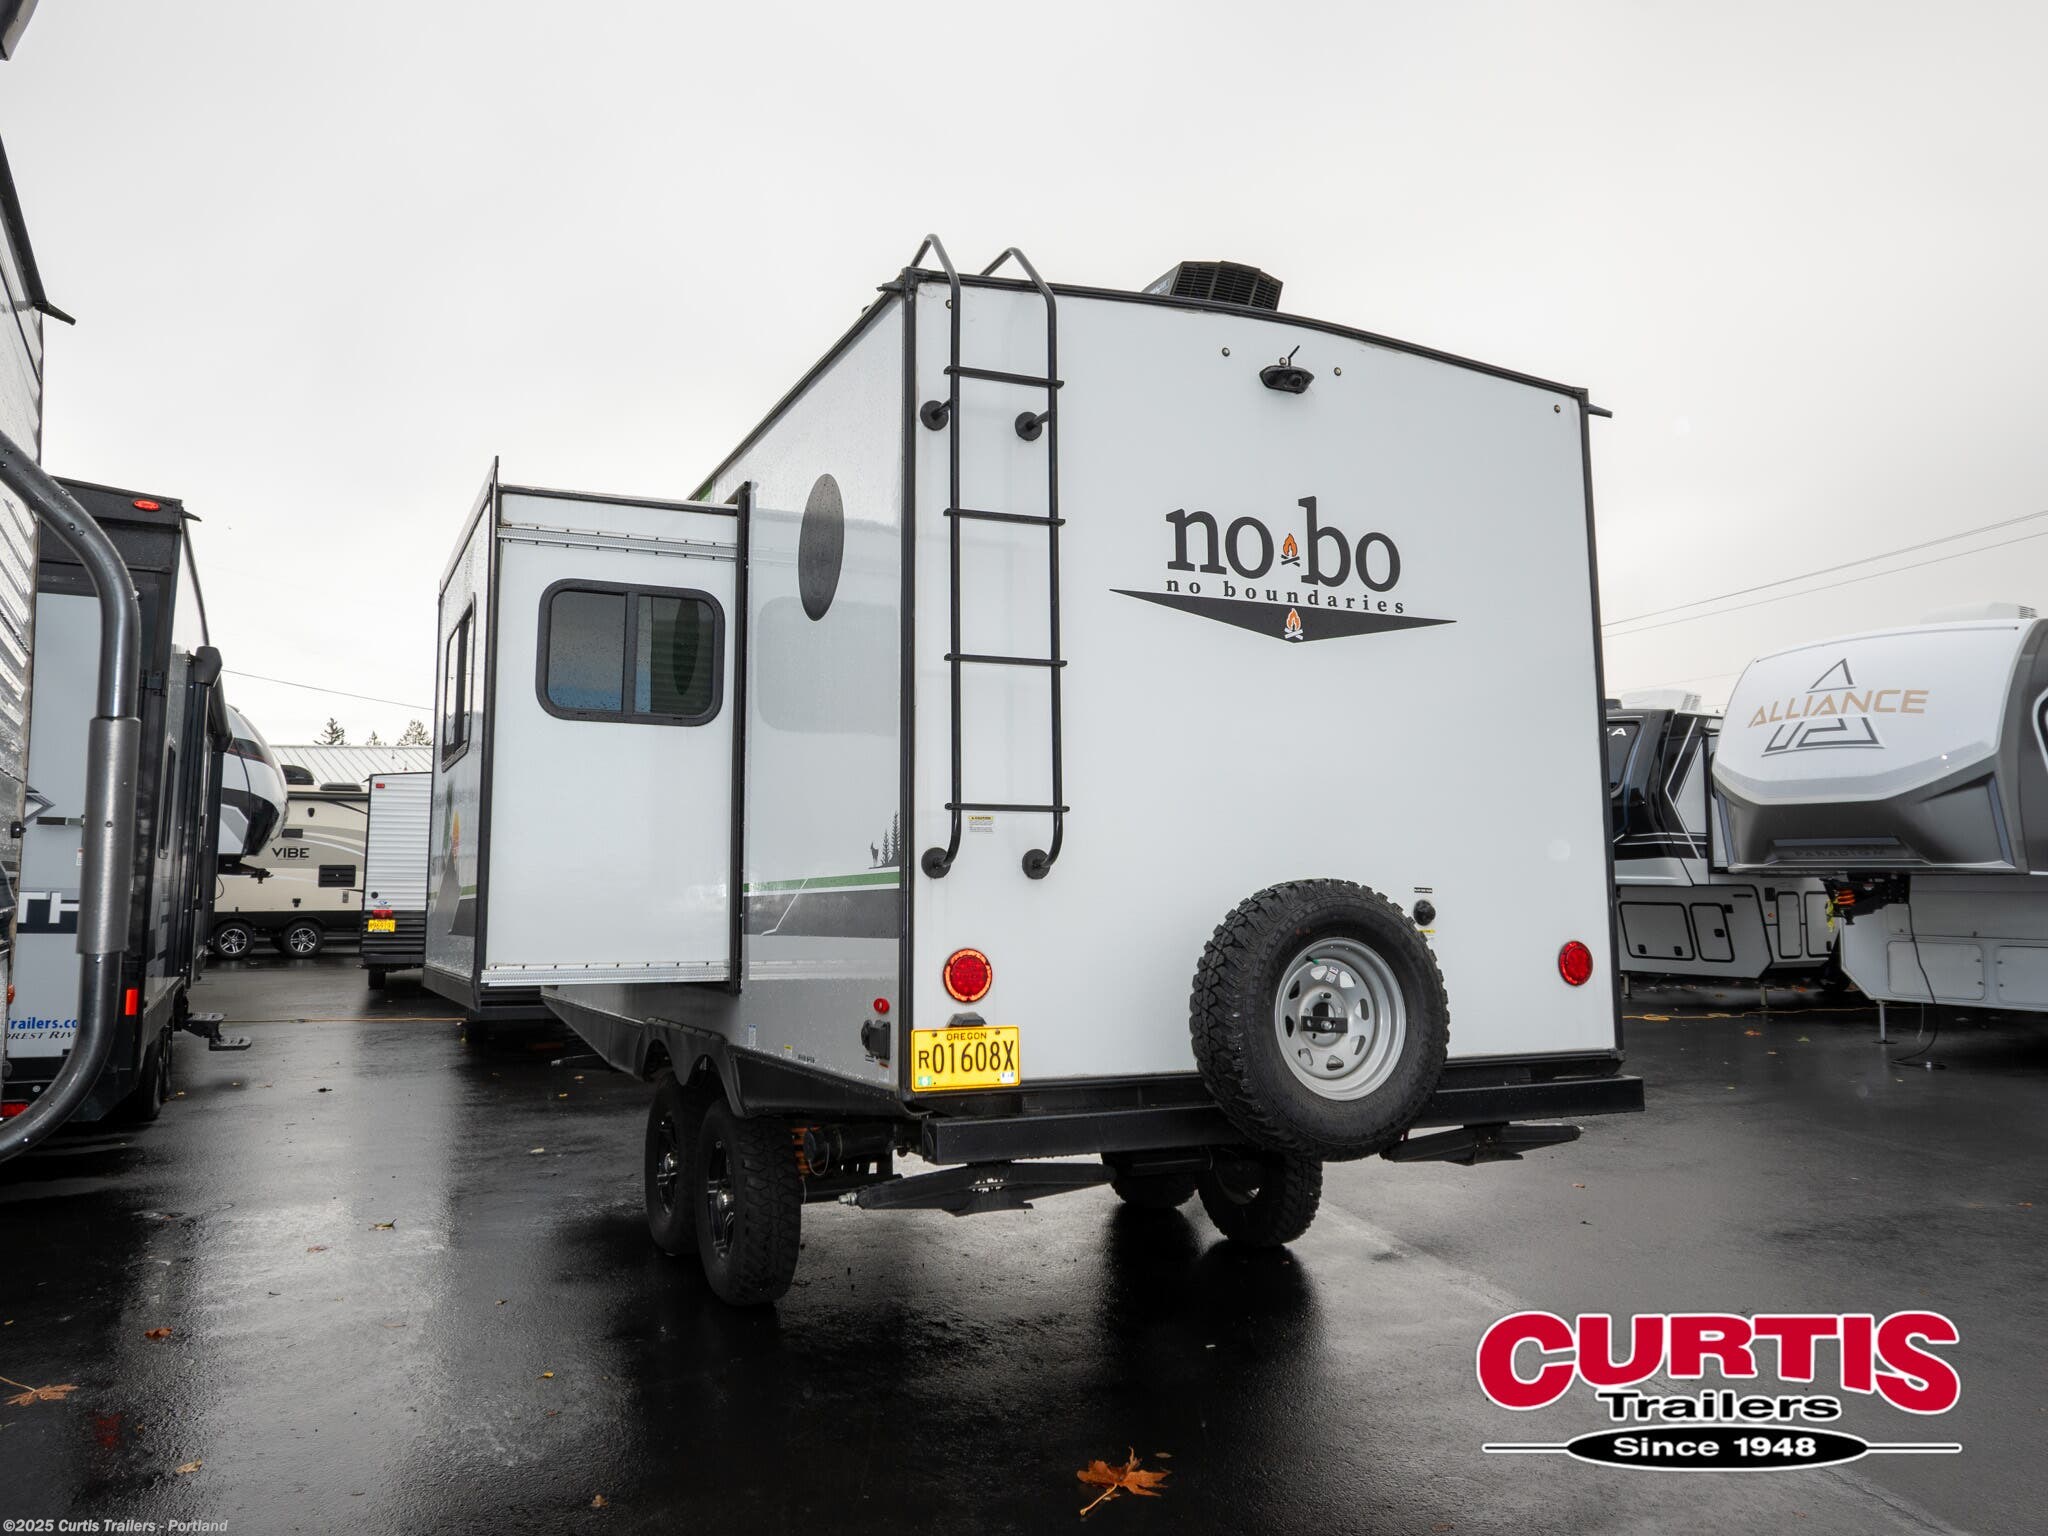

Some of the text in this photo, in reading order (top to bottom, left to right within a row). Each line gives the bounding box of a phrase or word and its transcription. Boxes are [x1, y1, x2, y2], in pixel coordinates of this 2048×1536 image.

[1166, 579, 1405, 615] no boundaries
[1747, 688, 1930, 729] ALLIANCE
[271, 847, 310, 858] VIBE
[7, 1016, 78, 1030] railers.co
[49, 1030, 76, 1039] RIV
[946, 1032, 988, 1041] OREGON
[918, 1040, 1015, 1074] R01608X
